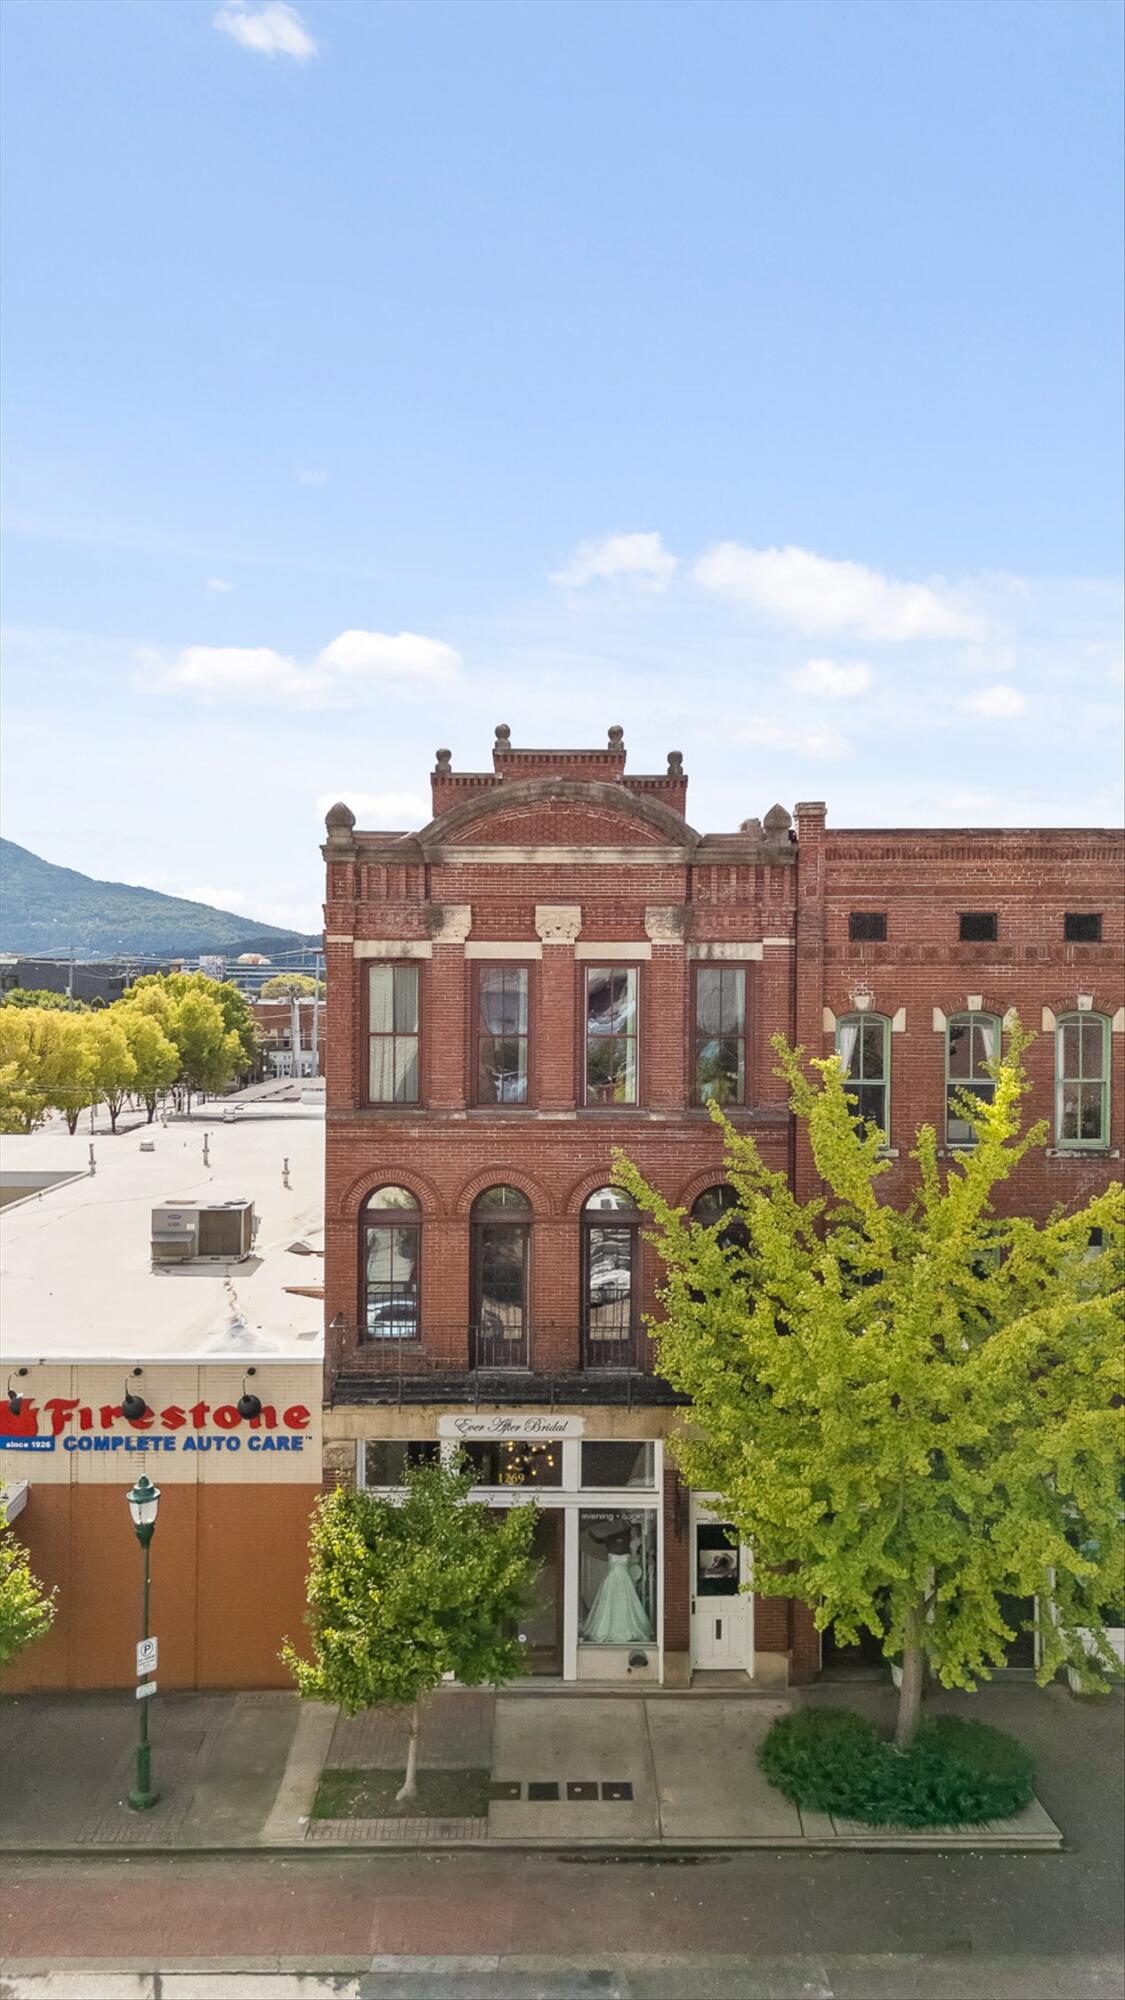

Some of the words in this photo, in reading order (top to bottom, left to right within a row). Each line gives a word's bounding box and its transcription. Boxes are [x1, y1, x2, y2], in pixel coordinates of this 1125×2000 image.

[44, 1398, 311, 1436] Firestone
[454, 1418, 485, 1434] Ever
[487, 1417, 522, 1435] After
[524, 1417, 568, 1433] Bridal
[6, 1440, 29, 1449] since
[31, 1440, 51, 1449] 1926
[63, 1435, 176, 1452] COMPLETE
[182, 1435, 241, 1452] AUTO
[247, 1435, 304, 1452] CARE
[144, 1644, 151, 1654] P
